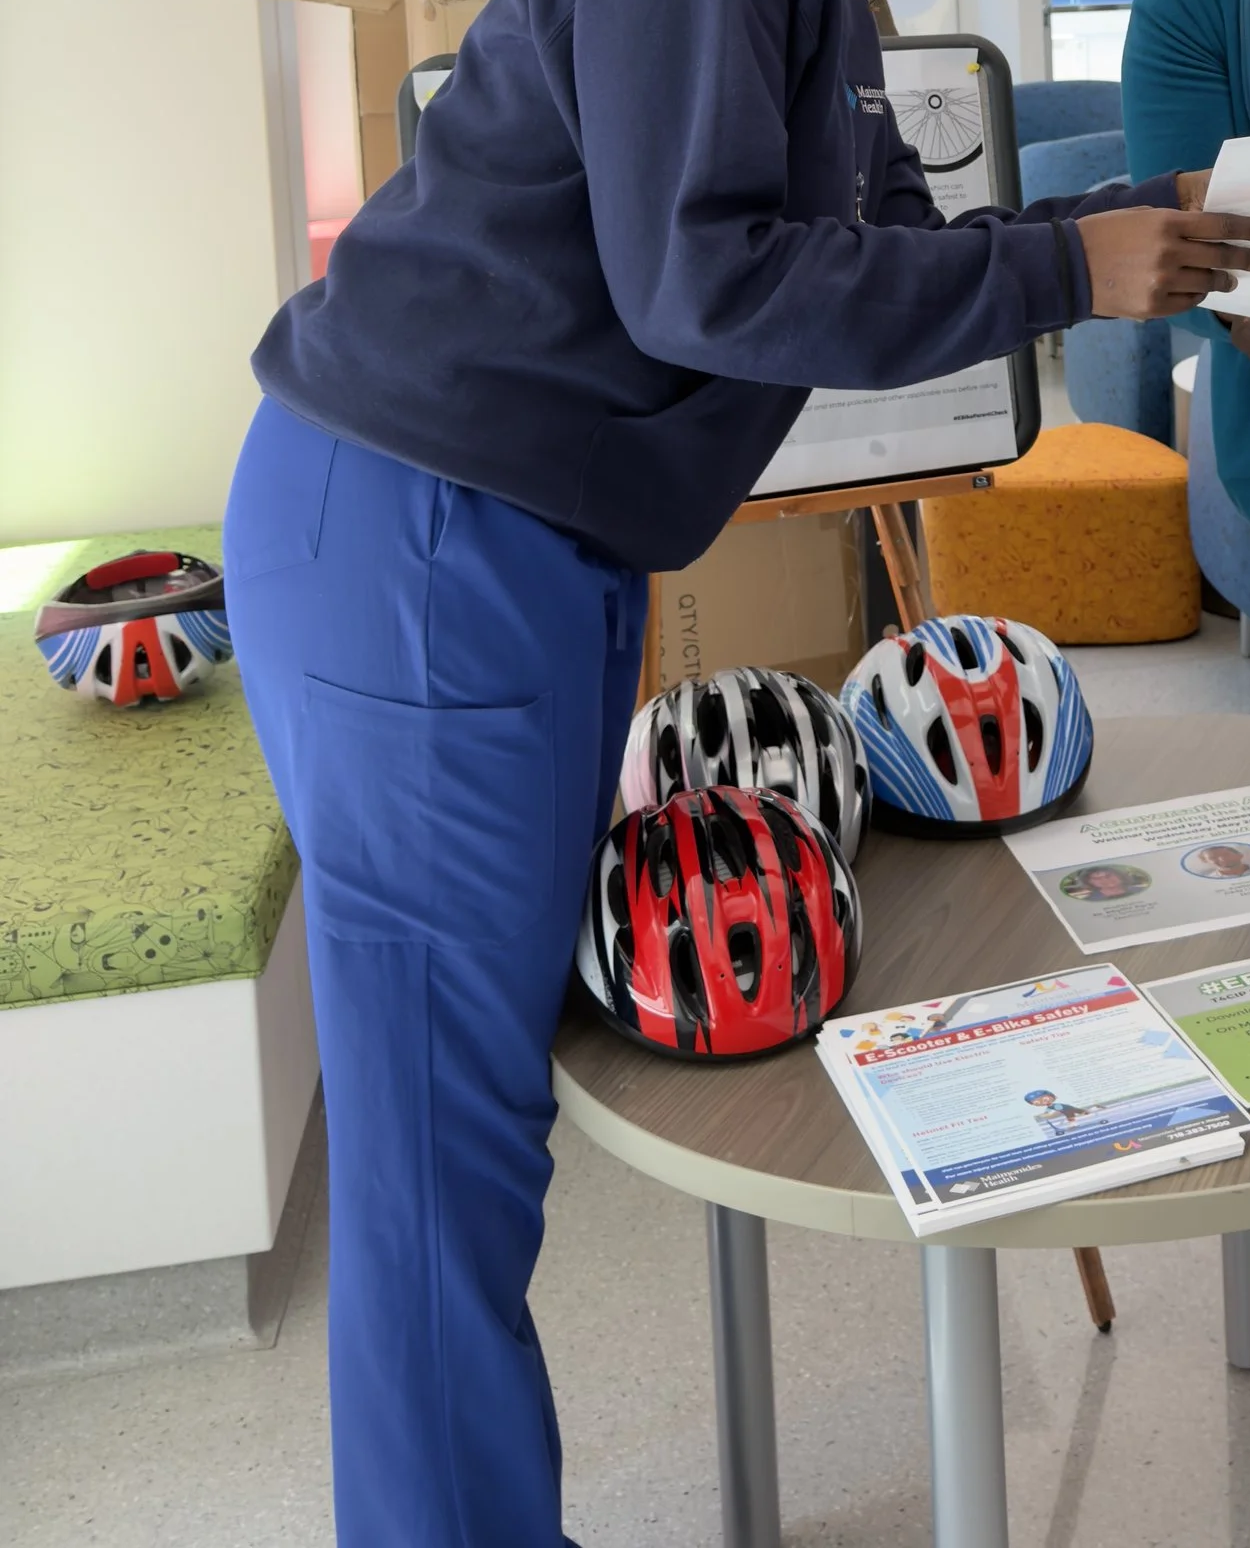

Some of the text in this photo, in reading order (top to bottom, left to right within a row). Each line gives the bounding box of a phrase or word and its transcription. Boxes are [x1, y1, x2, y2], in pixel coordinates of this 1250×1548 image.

[860, 99, 884, 114] Health
[938, 193, 957, 201] safest
[847, 398, 872, 408] policies
[888, 394, 905, 402] other
[1074, 822, 1099, 833] A
[1097, 798, 1241, 830] Conversation
[1089, 812, 1209, 839] Understanding
[1209, 807, 1238, 816] the
[1215, 820, 1244, 829] May
[1091, 831, 1143, 844] Webinar
[1143, 824, 1187, 835] hosted
[1208, 990, 1248, 1003] T4CIP
[863, 1034, 954, 1063] E-Scooter
[954, 1030, 971, 1041] &
[971, 1016, 1032, 1037] E-Bike
[1030, 1002, 1093, 1024] Safety
[1214, 1024, 1238, 1034] On
[1018, 1035, 1049, 1046] Safety
[966, 1114, 989, 1124] Test
[978, 1161, 1044, 1184] Maimonides
[982, 1173, 1019, 1188] Health
